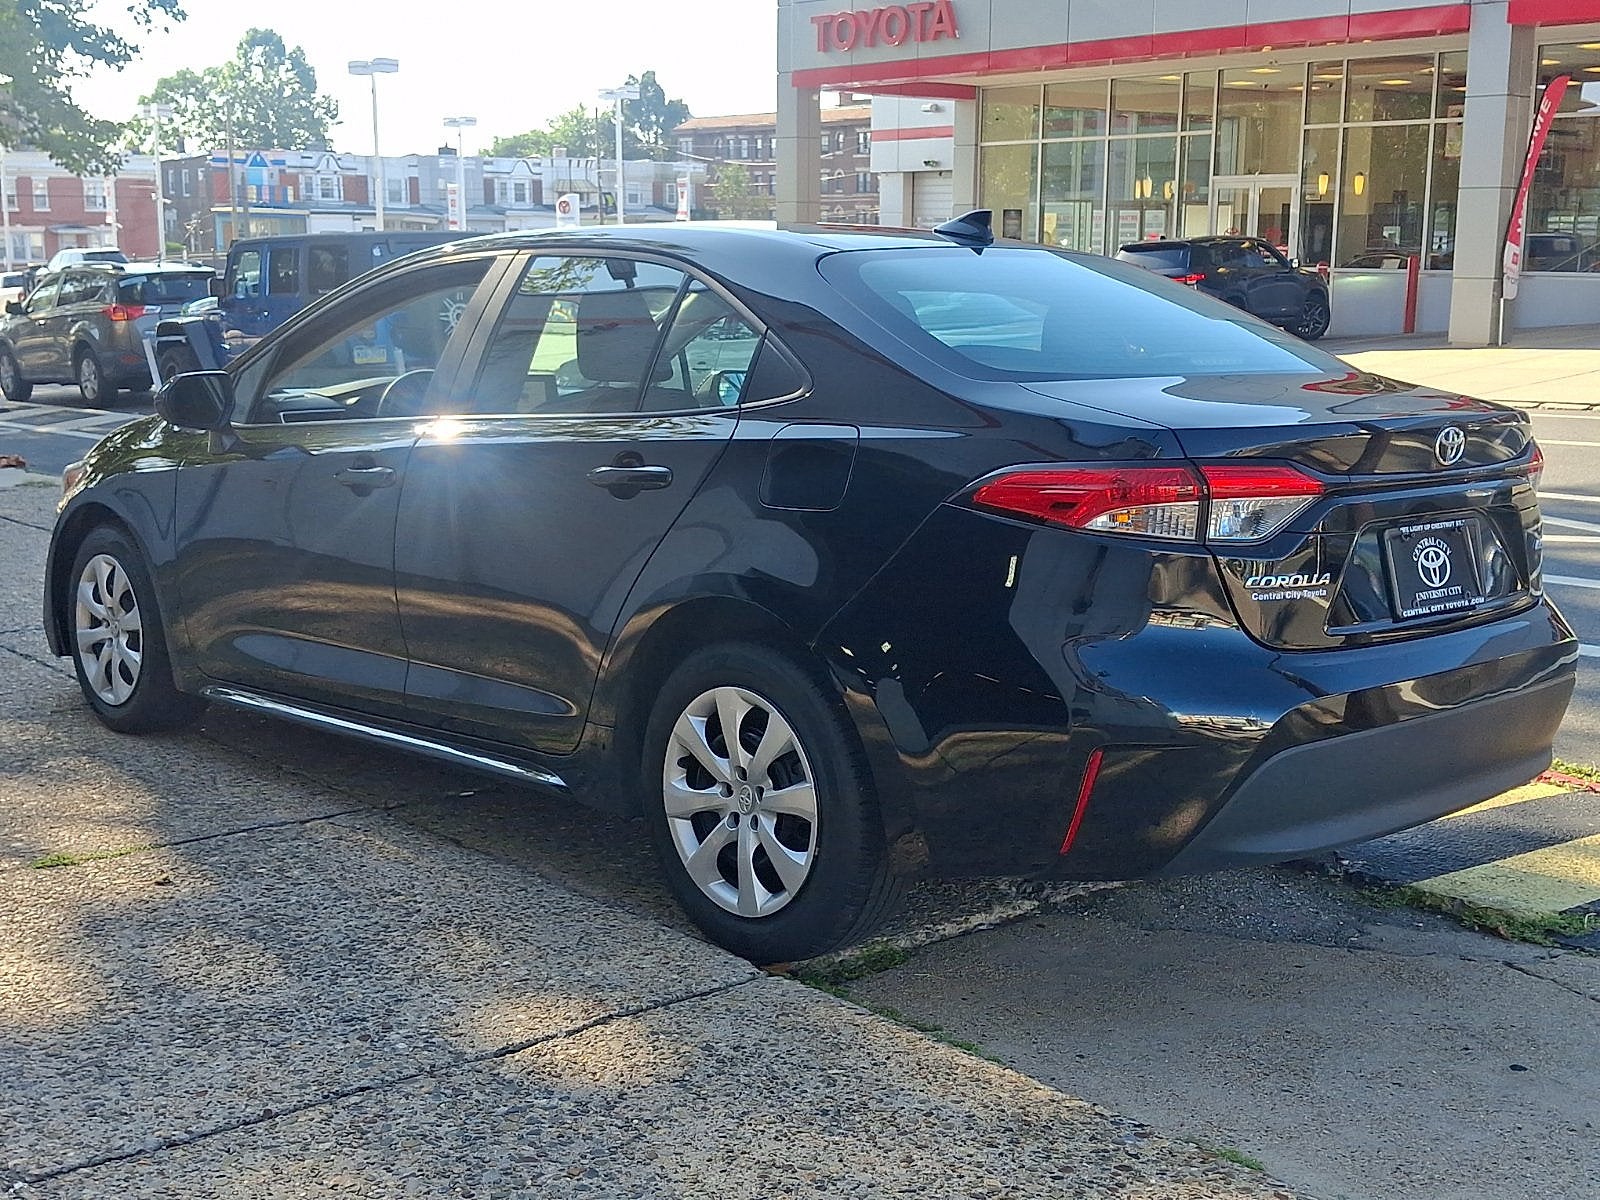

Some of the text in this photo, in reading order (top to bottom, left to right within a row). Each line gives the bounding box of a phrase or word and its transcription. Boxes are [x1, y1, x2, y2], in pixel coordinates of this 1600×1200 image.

[811, 0, 959, 52] TOYOTA
[1412, 537, 1452, 561] CENTRAL CITY
[1245, 573, 1330, 588] COROLLA
[1252, 589, 1327, 600] Central City Toyota
[1416, 585, 1462, 600] UNIVERSITY CITY
[1403, 608, 1430, 617] CENTRAL
[1431, 604, 1444, 612] CITY
[1445, 599, 1469, 610] TOYOTA
